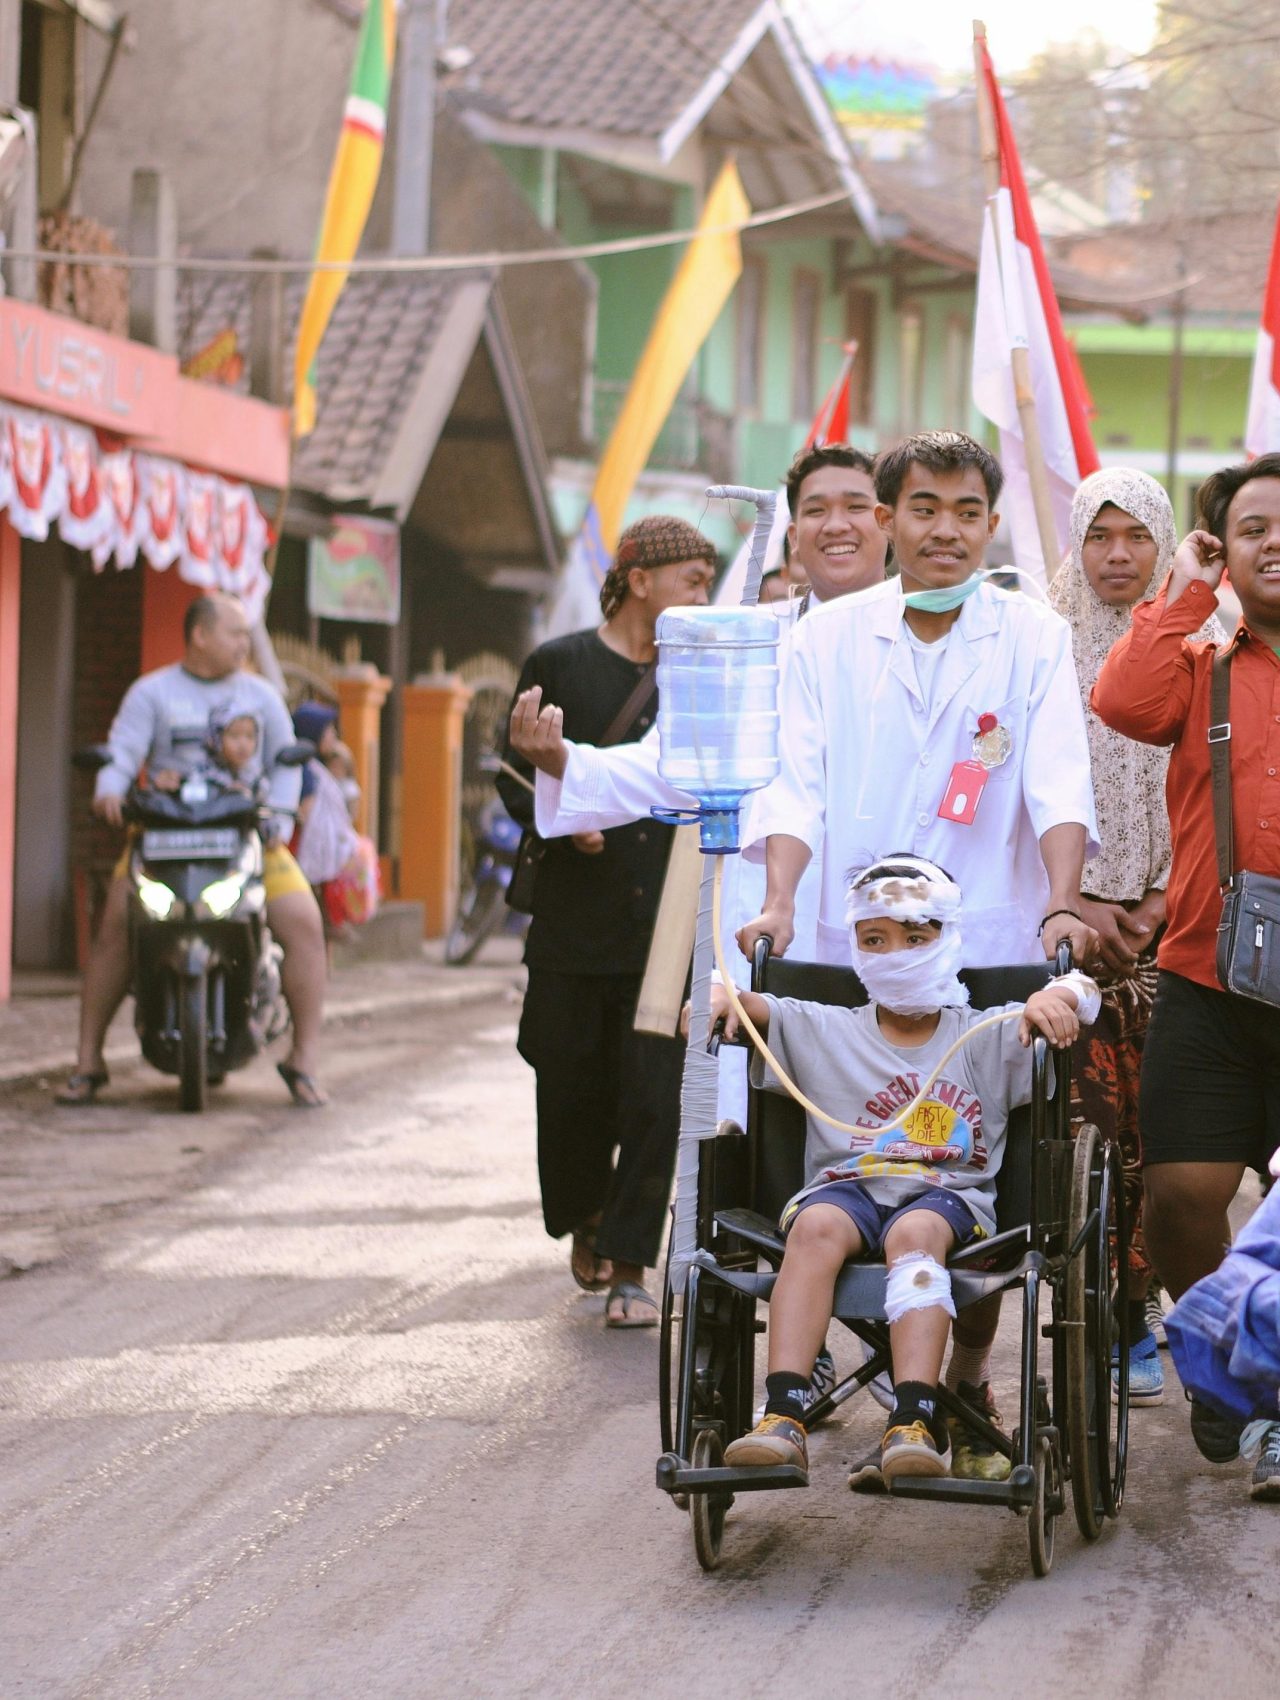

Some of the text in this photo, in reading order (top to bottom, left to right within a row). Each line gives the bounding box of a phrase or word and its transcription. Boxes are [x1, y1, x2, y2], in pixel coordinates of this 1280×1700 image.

[865, 1072, 921, 1120] GREAT
[916, 1106, 943, 1122] FAST
[916, 1130, 936, 1142] DIE
